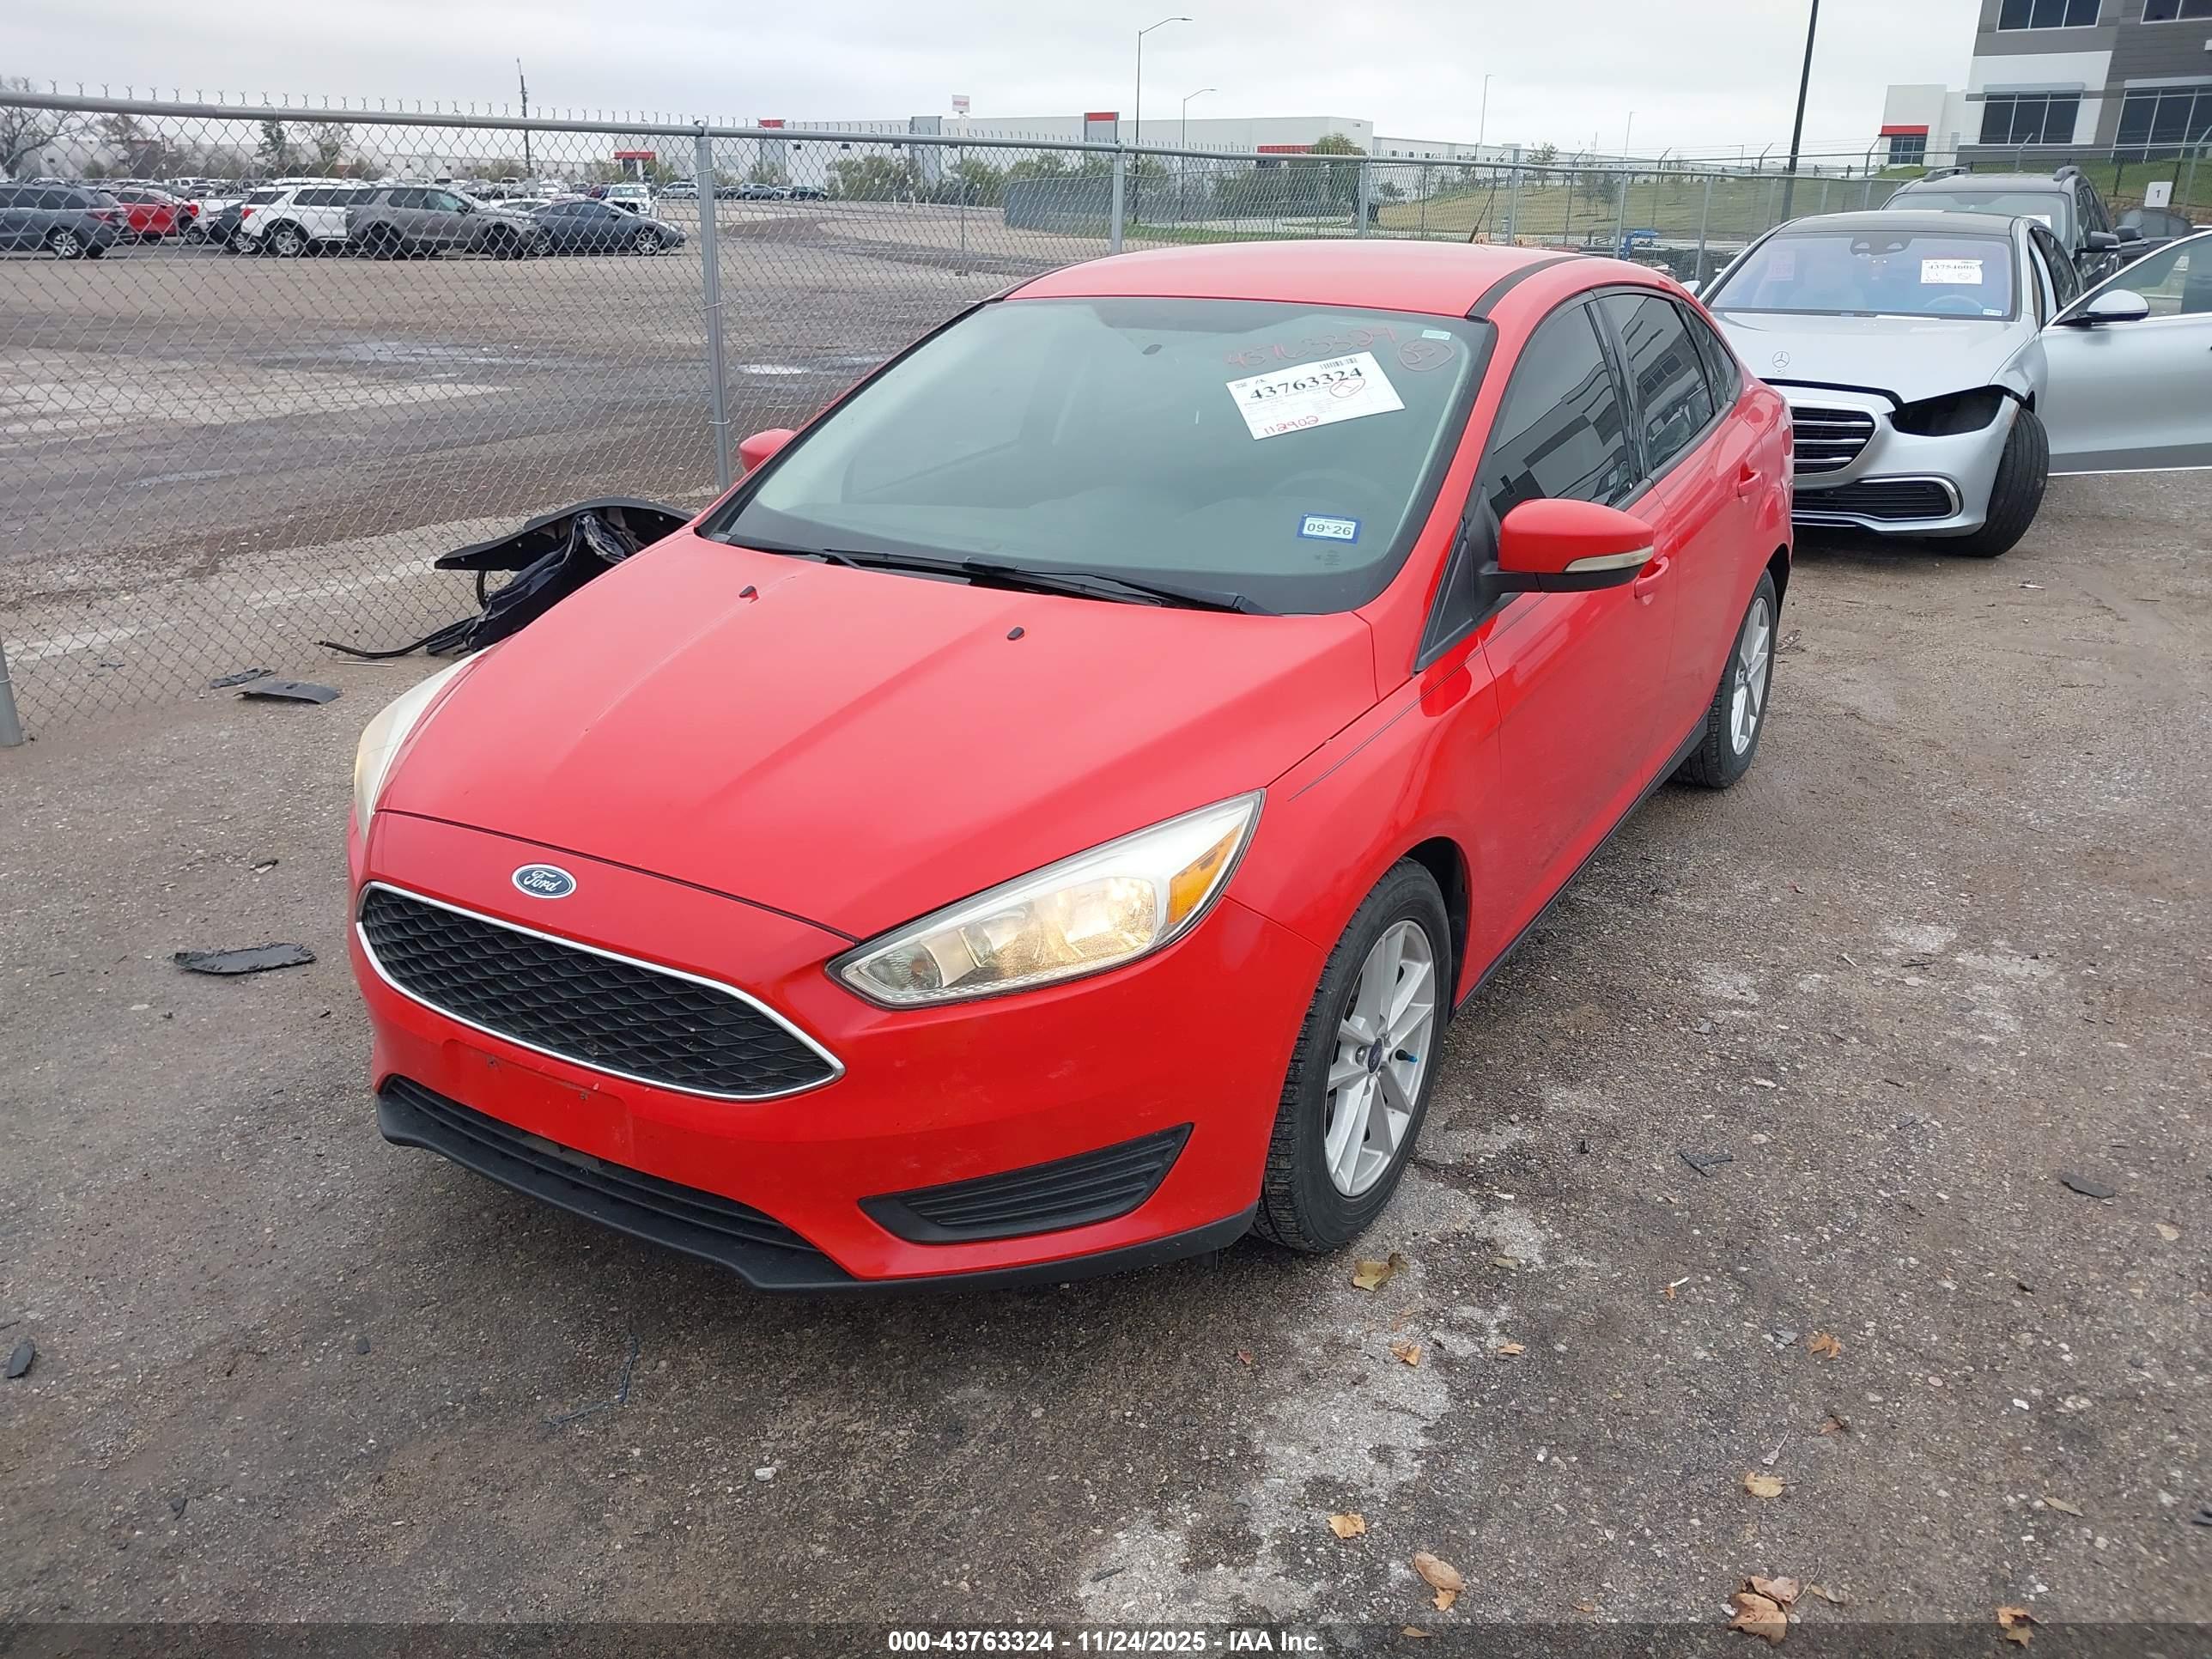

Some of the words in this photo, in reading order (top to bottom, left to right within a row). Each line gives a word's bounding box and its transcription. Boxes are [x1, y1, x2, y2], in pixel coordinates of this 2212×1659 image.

[2155, 189, 2160, 198] 1
[1250, 367, 1363, 399] 43763324
[523, 870, 562, 892] Ford
